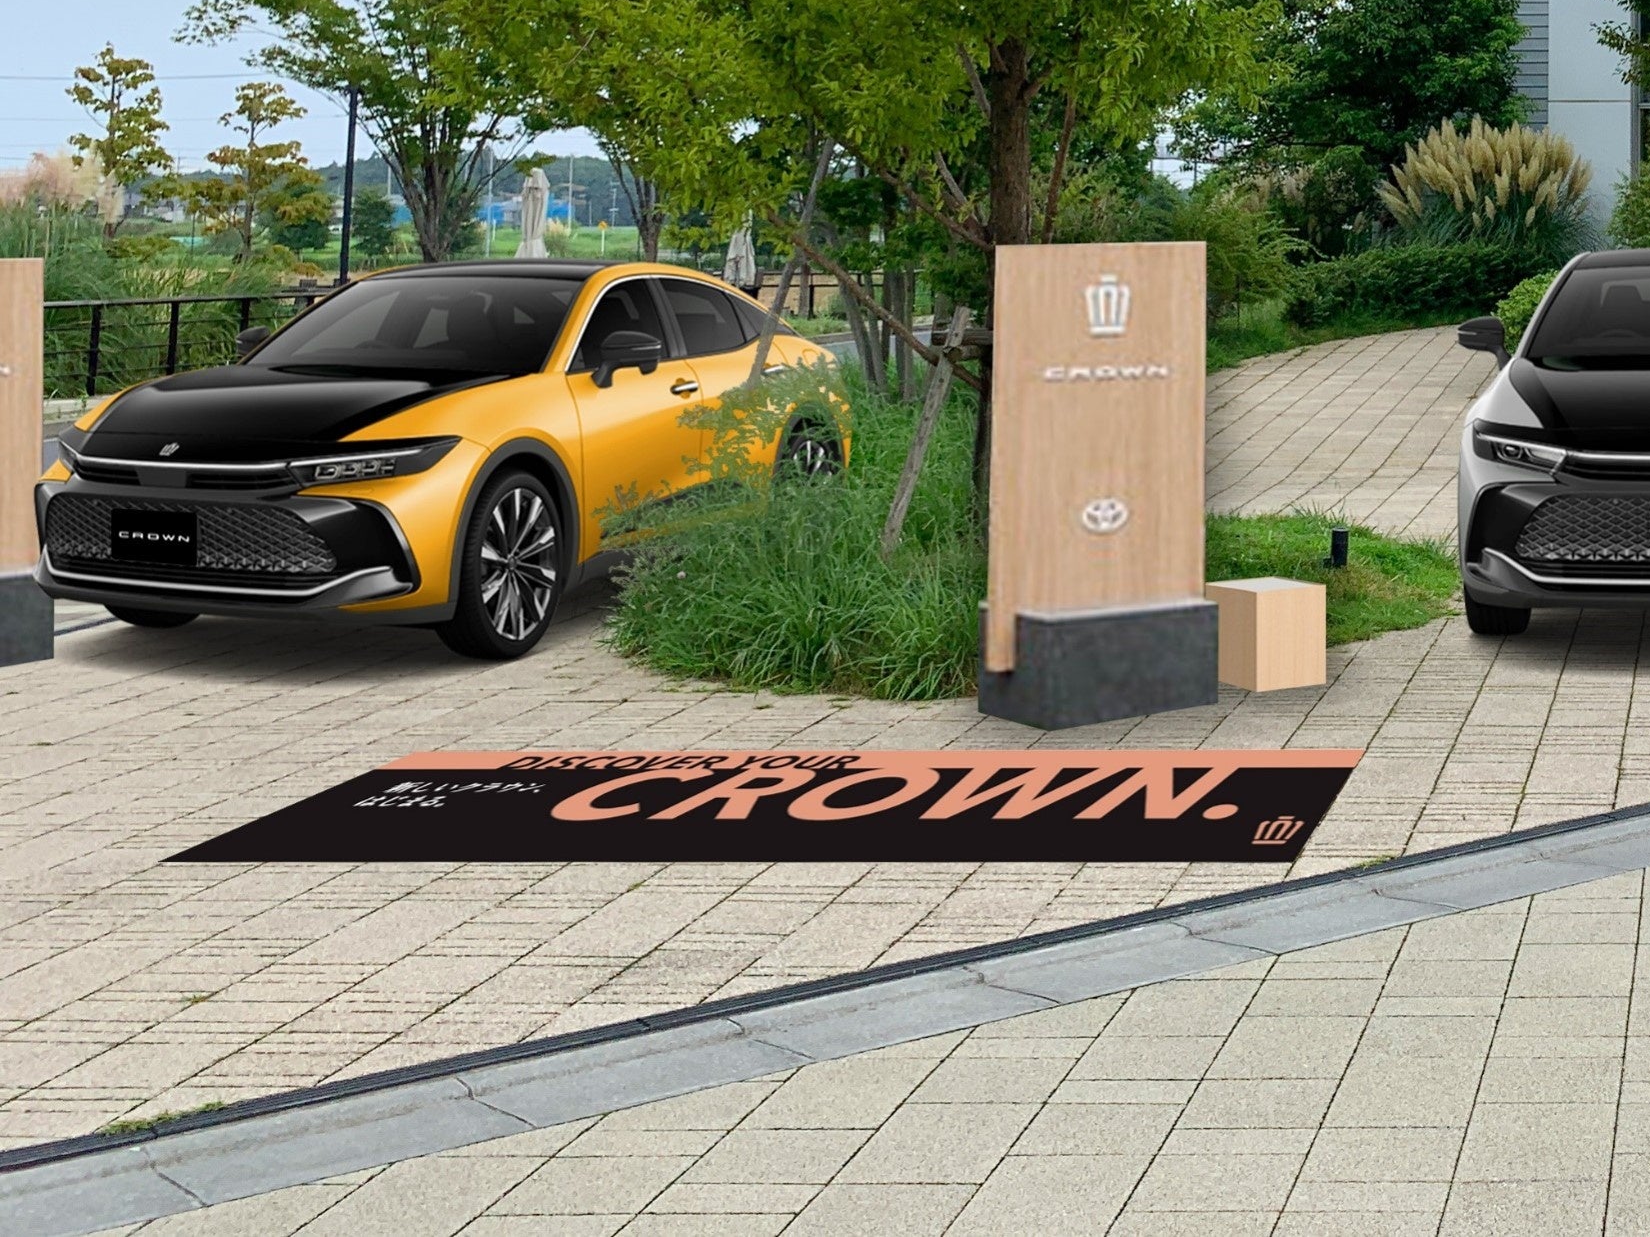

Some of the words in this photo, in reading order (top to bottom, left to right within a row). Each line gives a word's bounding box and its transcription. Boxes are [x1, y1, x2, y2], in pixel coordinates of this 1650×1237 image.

[1044, 365, 1169, 380] CROWN
[118, 530, 190, 543] CROWN
[497, 755, 729, 770] DISCOVER
[736, 755, 861, 770] YOUR
[550, 767, 1240, 821] CROWN.
